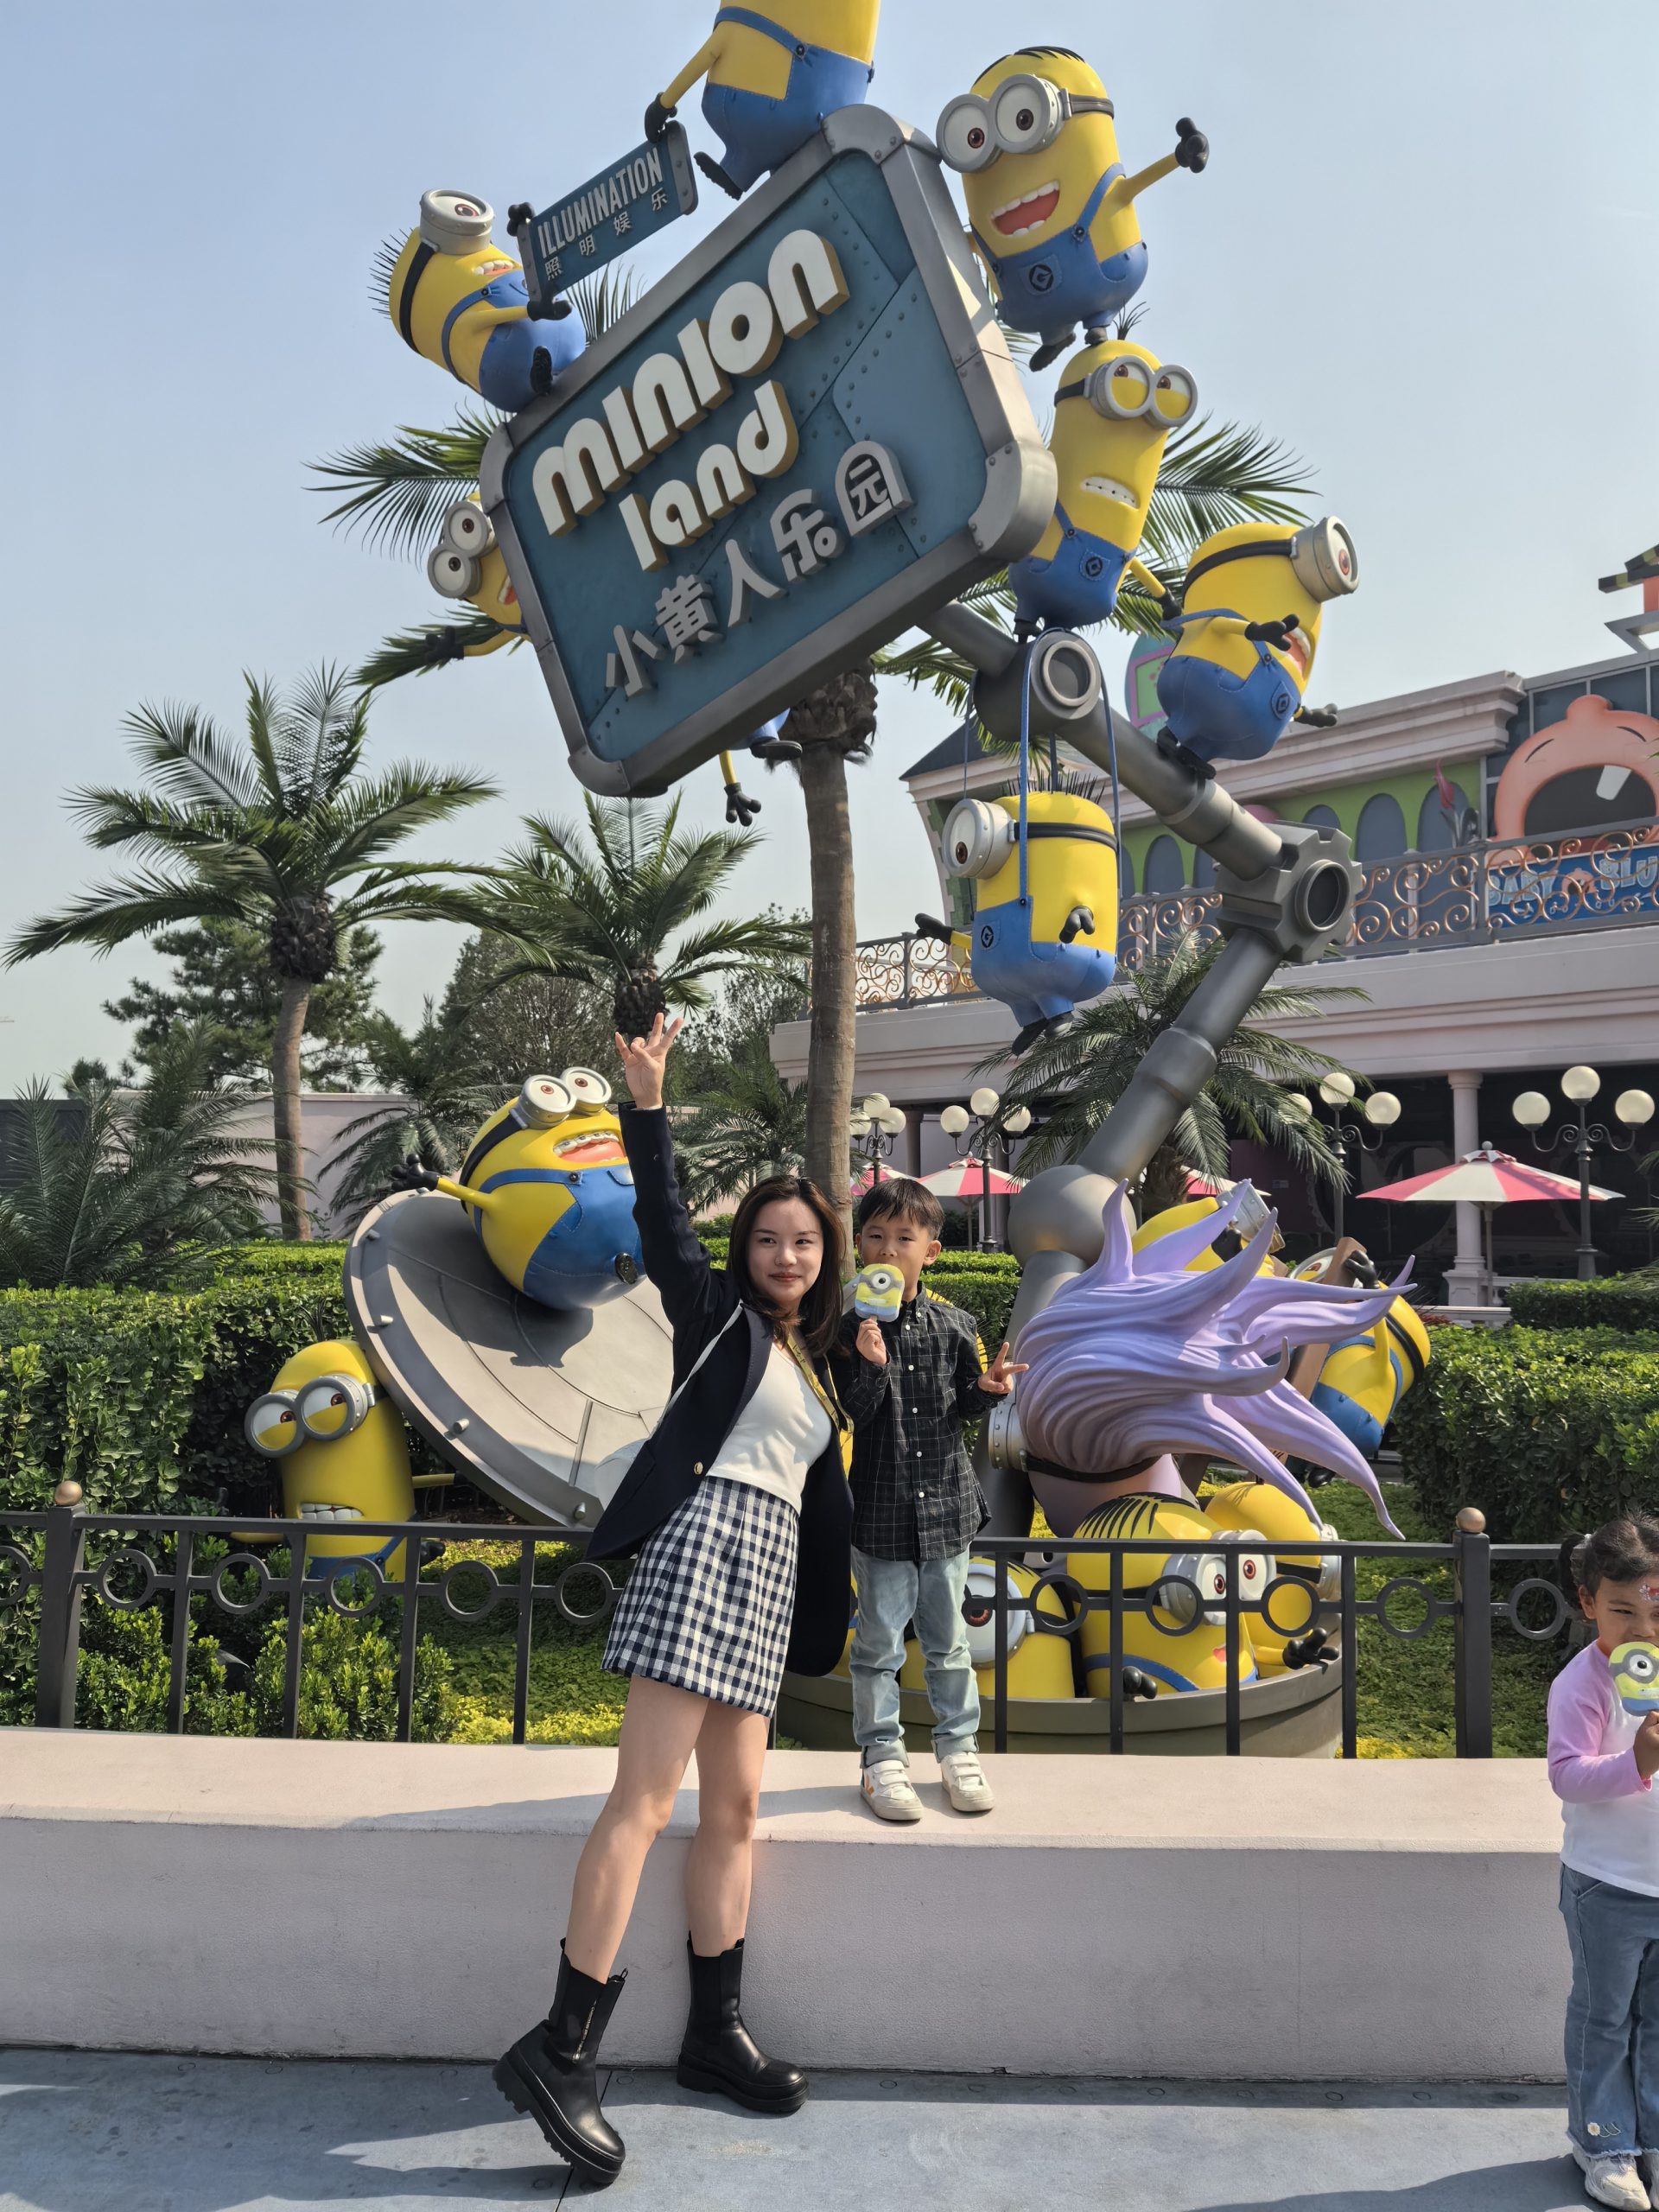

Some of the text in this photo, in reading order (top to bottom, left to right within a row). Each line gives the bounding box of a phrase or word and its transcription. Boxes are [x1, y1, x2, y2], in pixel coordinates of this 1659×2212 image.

[537, 147, 664, 258] ILLUMINATION
[544, 187, 669, 281] 照明娱乐
[606, 441, 912, 696] 小黄人乐园
[1488, 855, 1659, 906] BABY BLU
